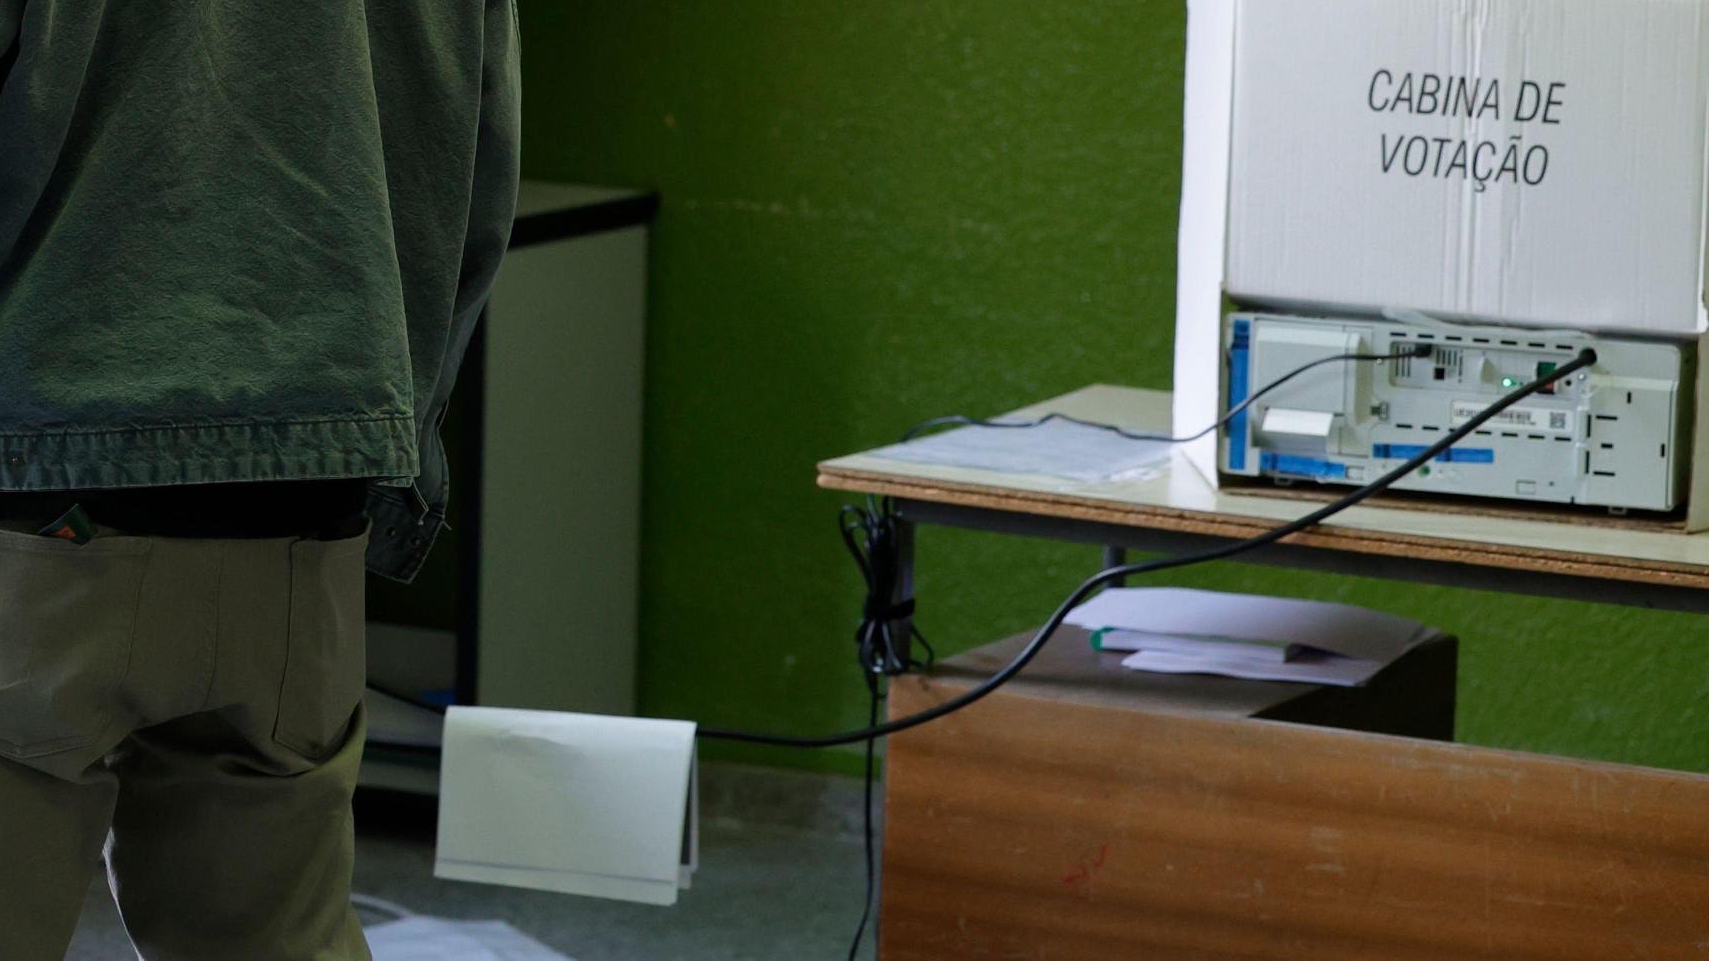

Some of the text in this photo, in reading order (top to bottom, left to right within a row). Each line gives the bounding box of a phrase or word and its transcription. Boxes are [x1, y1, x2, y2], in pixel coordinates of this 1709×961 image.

[1367, 69, 1566, 125] CABINA DE
[1380, 133, 1551, 193] VOTAÇÃO
